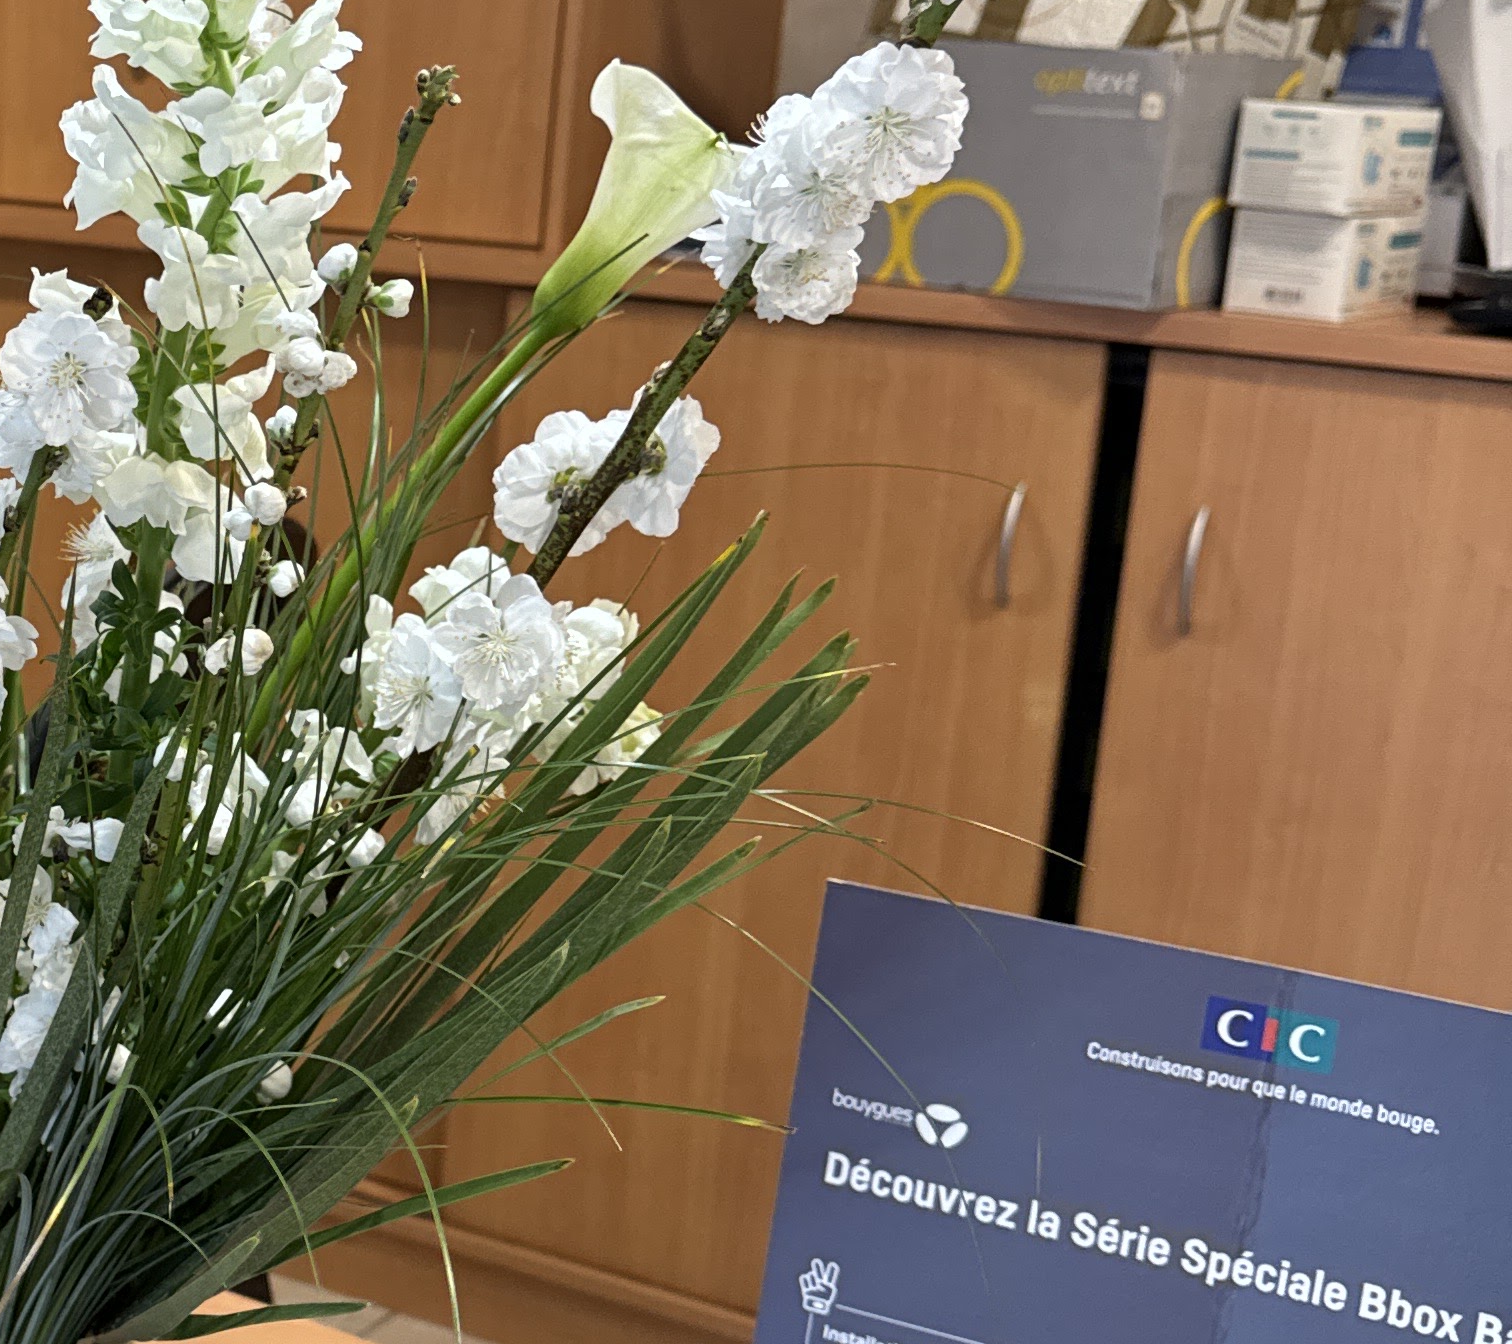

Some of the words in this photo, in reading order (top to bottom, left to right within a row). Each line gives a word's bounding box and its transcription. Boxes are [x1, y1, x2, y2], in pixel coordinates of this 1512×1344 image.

[1216, 1009, 1326, 1064] CIC
[832, 1087, 914, 1122] bouygues
[1087, 1041, 1204, 1082] Construisons
[1206, 1069, 1249, 1091] pour
[1252, 1079, 1285, 1101] que
[1289, 1083, 1307, 1105] le
[1310, 1091, 1373, 1120] monde
[1376, 1103, 1441, 1136] bouge.
[823, 1150, 1019, 1231] Découvrez
[1026, 1199, 1061, 1241] la
[1070, 1211, 1171, 1267] Série
[1180, 1237, 1348, 1312] Spéciale
[1357, 1281, 1464, 1344] Bbox
